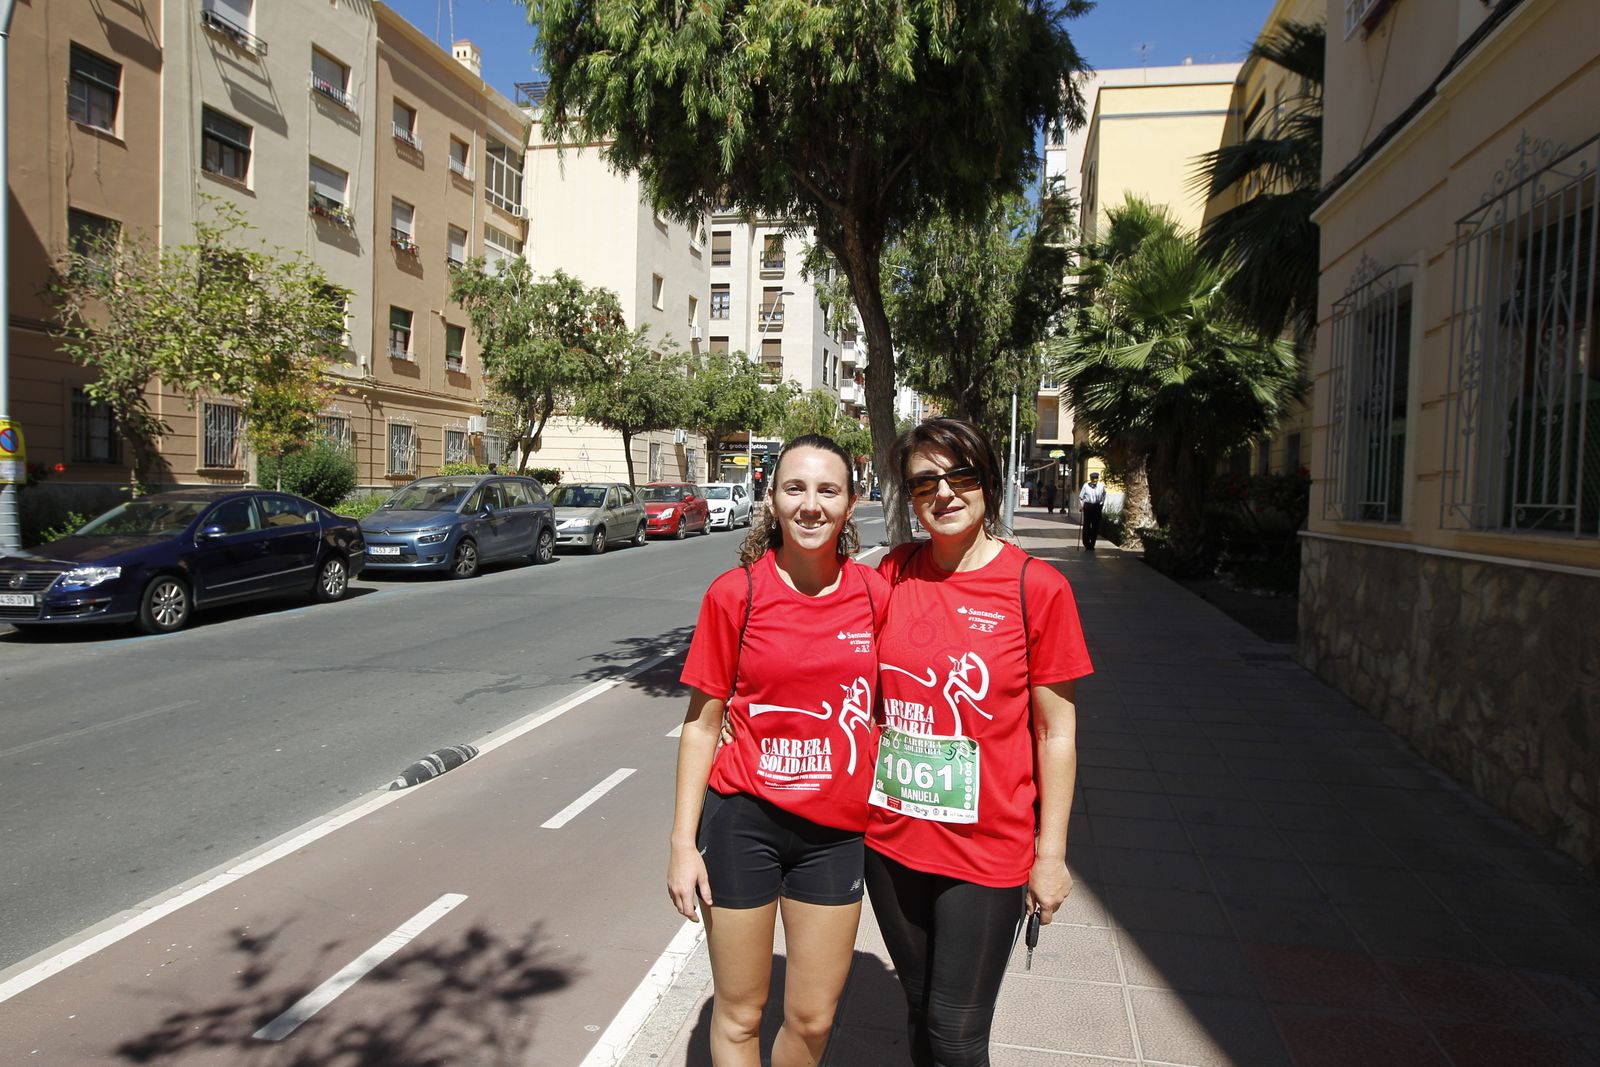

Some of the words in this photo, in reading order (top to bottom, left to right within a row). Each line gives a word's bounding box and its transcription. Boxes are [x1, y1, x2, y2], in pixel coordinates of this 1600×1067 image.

[968, 608, 1005, 621] Santander
[884, 698, 934, 724] ARRERA
[760, 737, 832, 758] CARRERA
[904, 736, 941, 749] CARRERA
[904, 743, 941, 756] SOLIDARIA
[759, 754, 832, 774] SOLIDARIA
[884, 753, 953, 791] 1061
[901, 786, 940, 804] MANUELA
